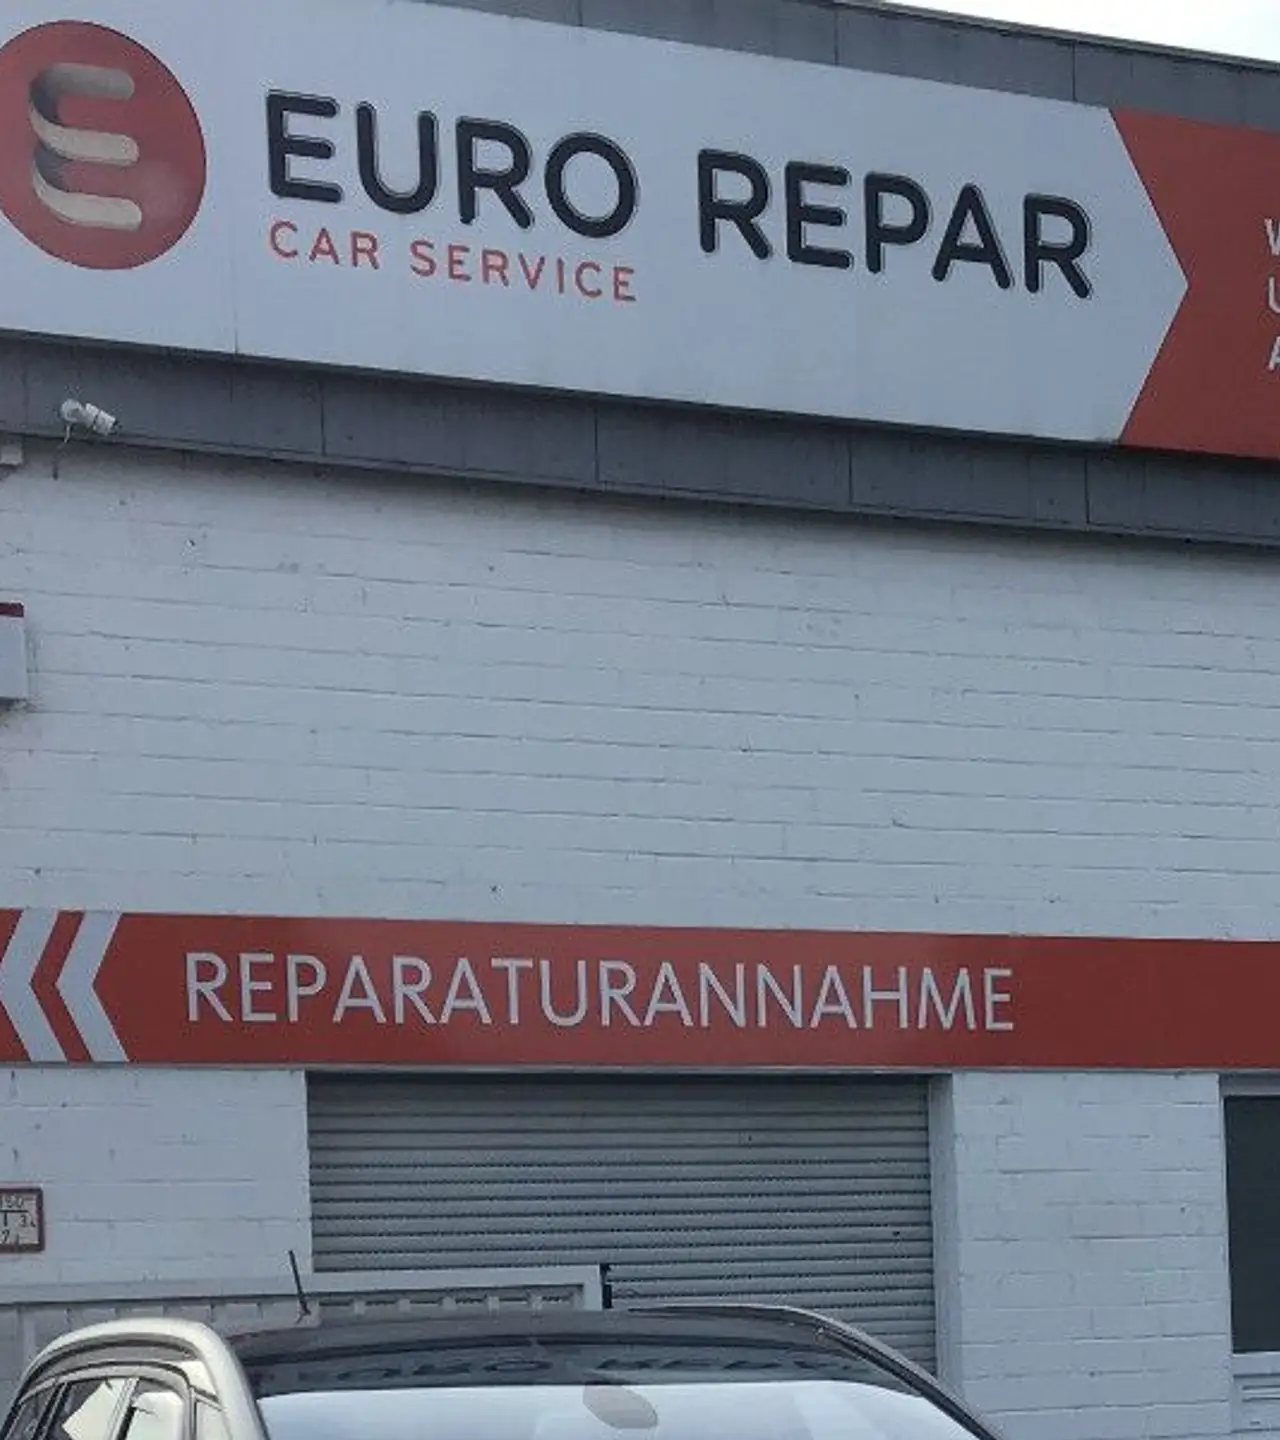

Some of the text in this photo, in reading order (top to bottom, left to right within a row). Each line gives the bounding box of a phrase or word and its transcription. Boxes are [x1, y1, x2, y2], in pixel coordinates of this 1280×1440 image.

[266, 90, 1094, 300] EURO REPAR
[270, 221, 638, 303] CAR SERVICE
[186, 952, 1015, 1032] REPARATURANNAHME
